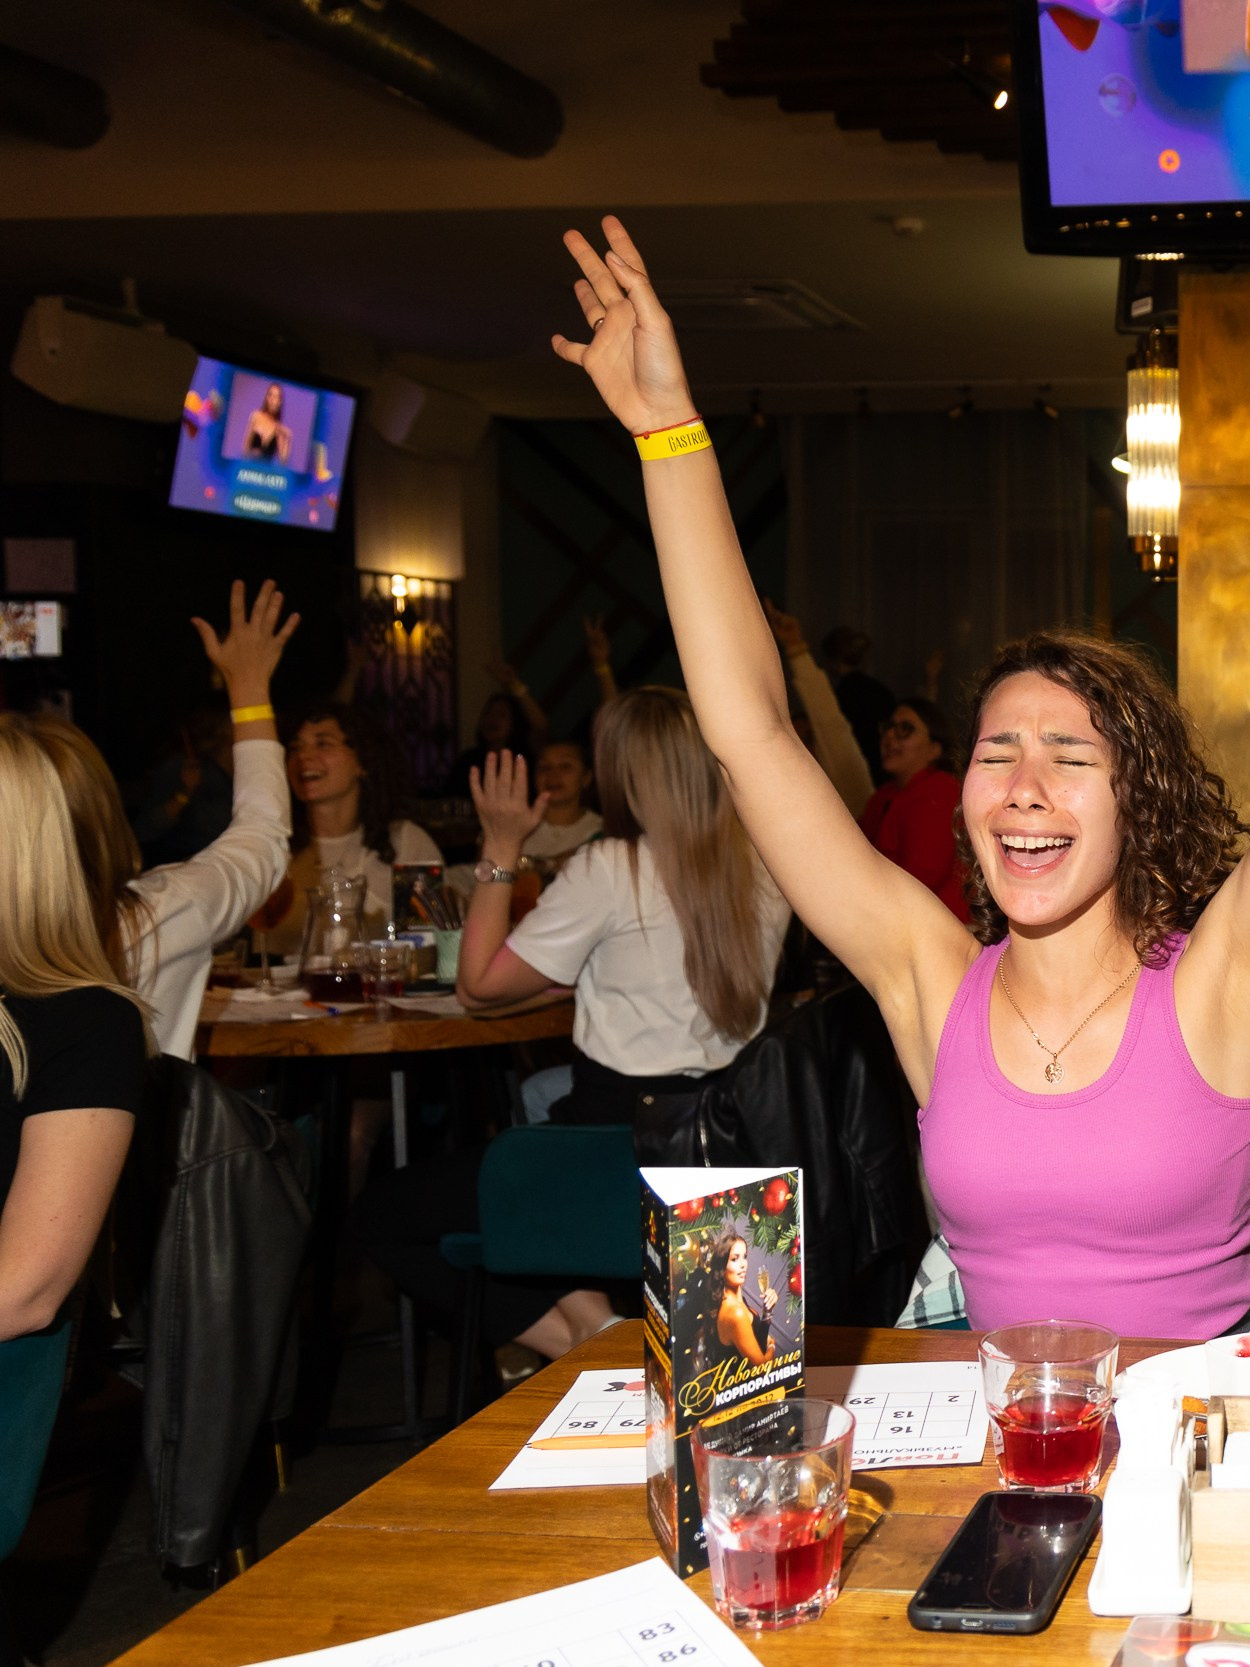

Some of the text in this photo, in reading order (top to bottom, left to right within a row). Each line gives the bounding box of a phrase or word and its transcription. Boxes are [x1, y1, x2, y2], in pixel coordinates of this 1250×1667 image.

[678, 1349, 801, 1415] Новогодние
[715, 1361, 802, 1406] КОРПОРАТИВЫ
[849, 1395, 960, 1405] 29 2
[893, 1410, 914, 1418] 13
[568, 1420, 598, 1429] 86
[890, 1426, 913, 1434] 16
[854, 1445, 963, 1454] «МУЗЫКАЛЬНО
[638, 1622, 676, 1641] 83
[658, 1643, 697, 1663] 86
